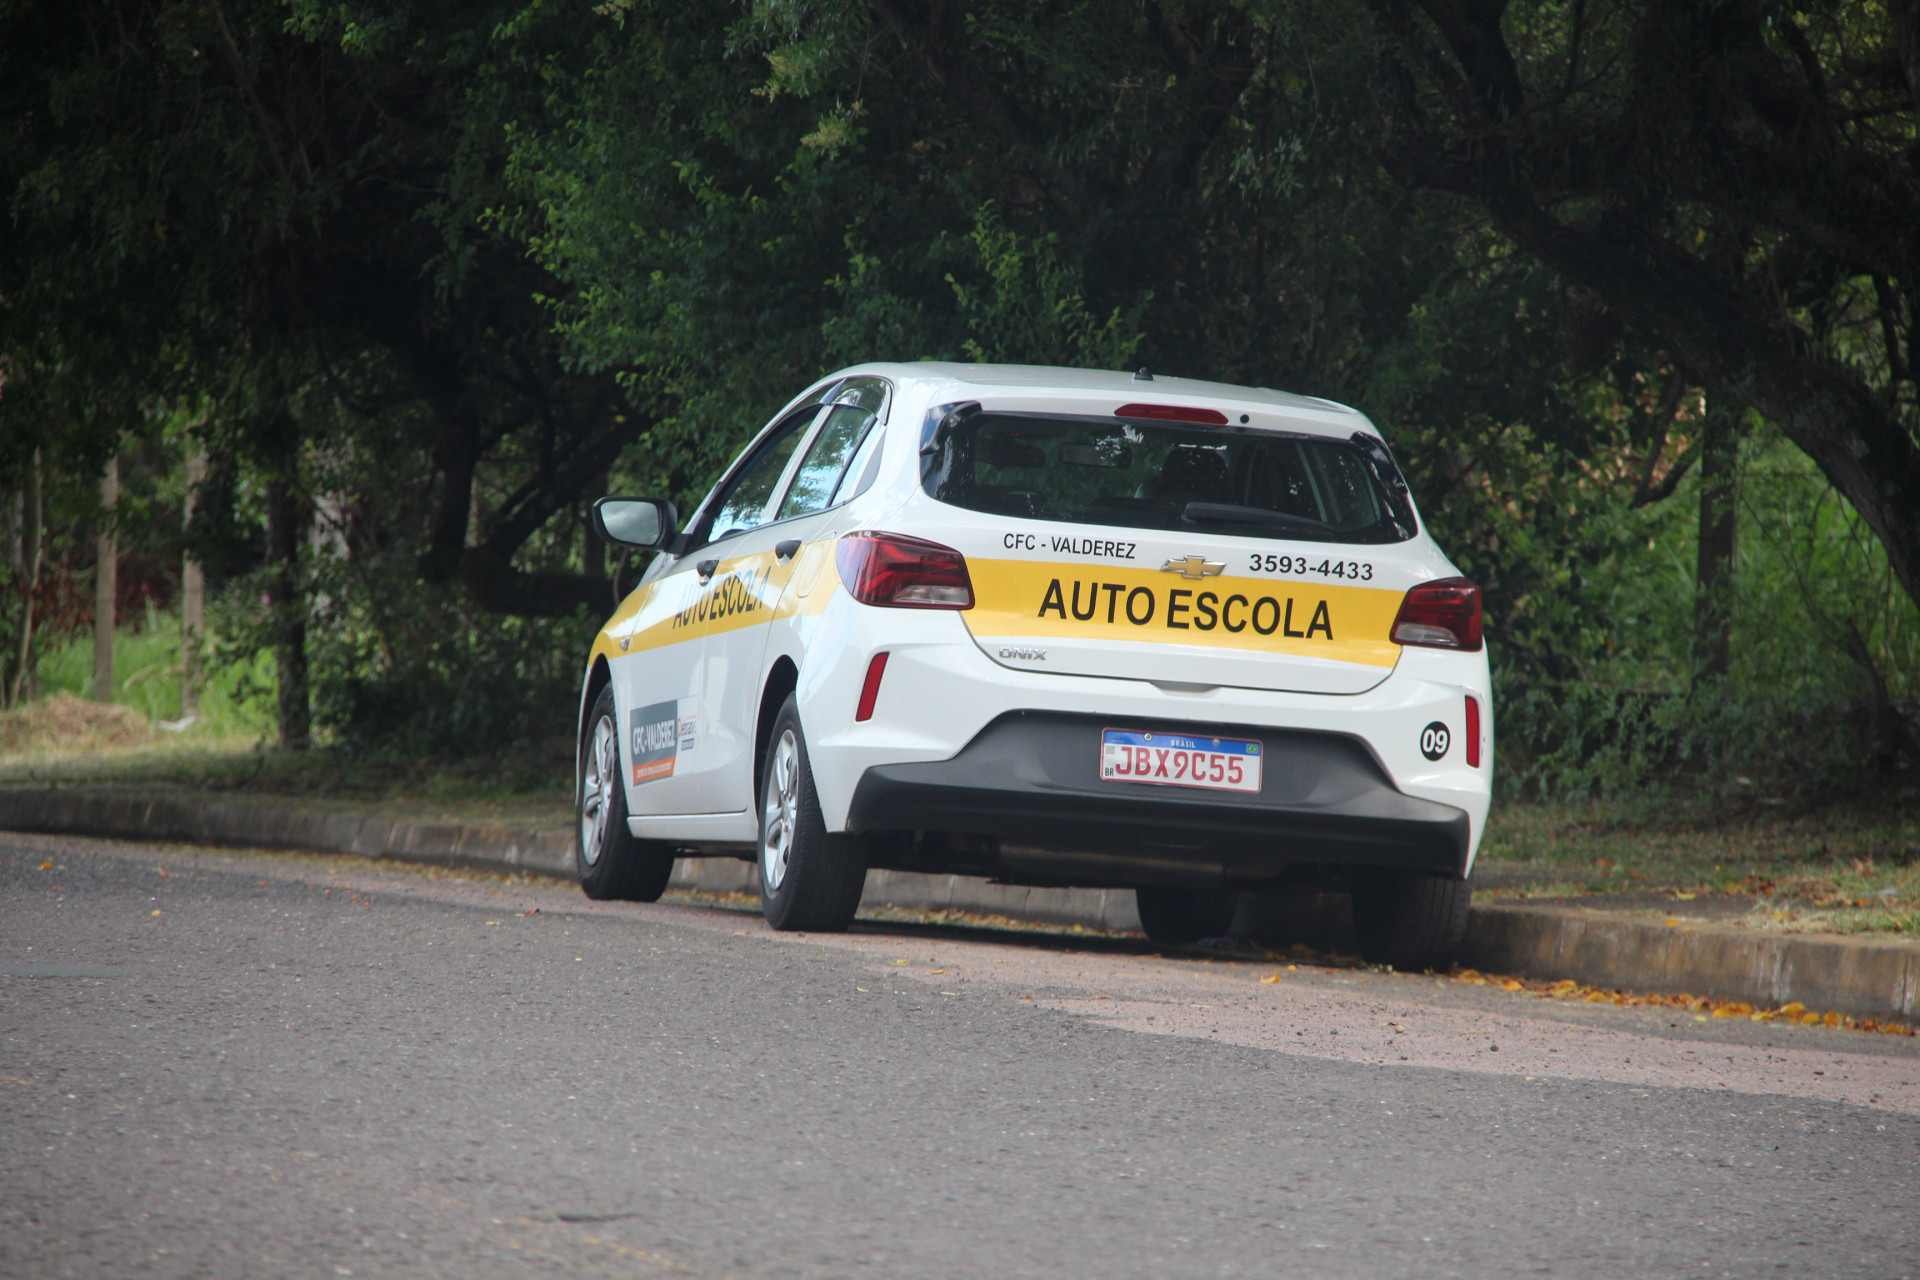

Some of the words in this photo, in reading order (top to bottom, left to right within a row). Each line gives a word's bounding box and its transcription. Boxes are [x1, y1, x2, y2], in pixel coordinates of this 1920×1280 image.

[1003, 532, 1036, 551] CFC
[1050, 537, 1136, 560] VALDEREZ
[1249, 554, 1374, 581] 3593-4433
[1038, 578, 1156, 626] AUTO
[1166, 588, 1334, 641] ESCOLA
[1422, 729, 1448, 753] 09
[1115, 746, 1244, 784] JBX9C55
